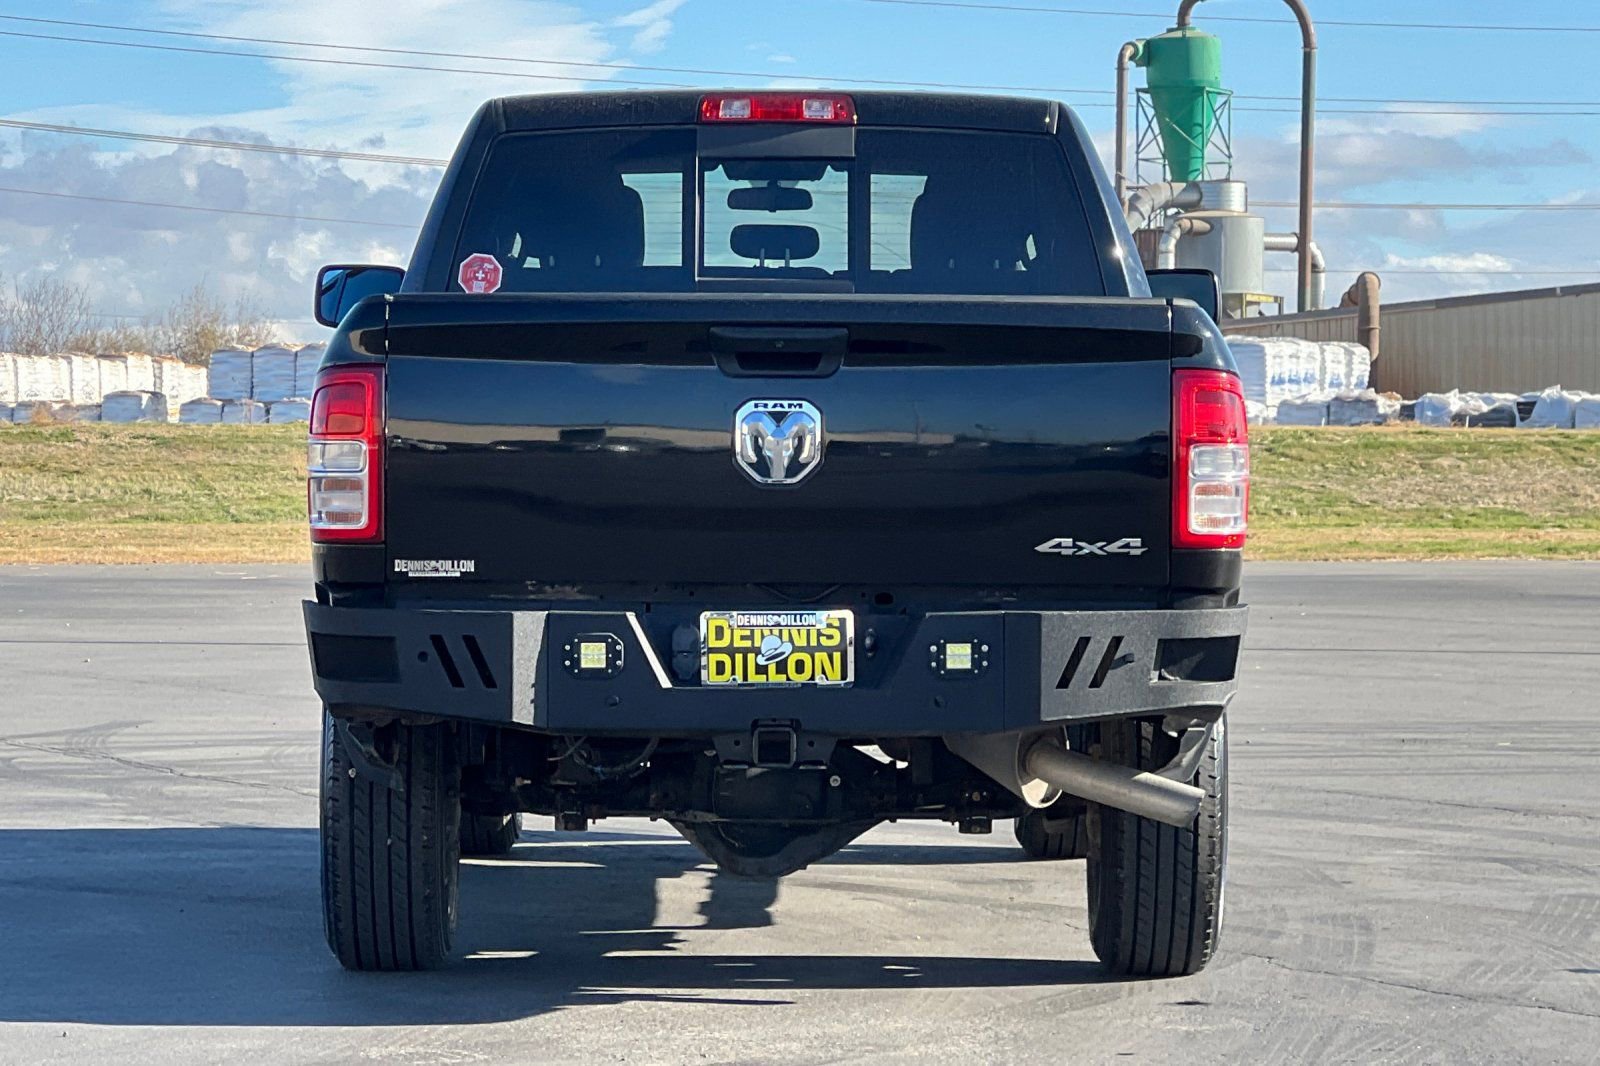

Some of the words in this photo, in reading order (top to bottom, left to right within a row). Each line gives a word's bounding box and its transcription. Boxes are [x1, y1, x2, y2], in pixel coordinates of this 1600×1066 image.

[1034, 538, 1148, 555] 4x4
[394, 559, 430, 572] DENNIS
[439, 559, 475, 572] DILLON
[737, 614, 773, 626] DENNIS
[780, 614, 816, 626] DILLON
[708, 651, 841, 682] DILLON
